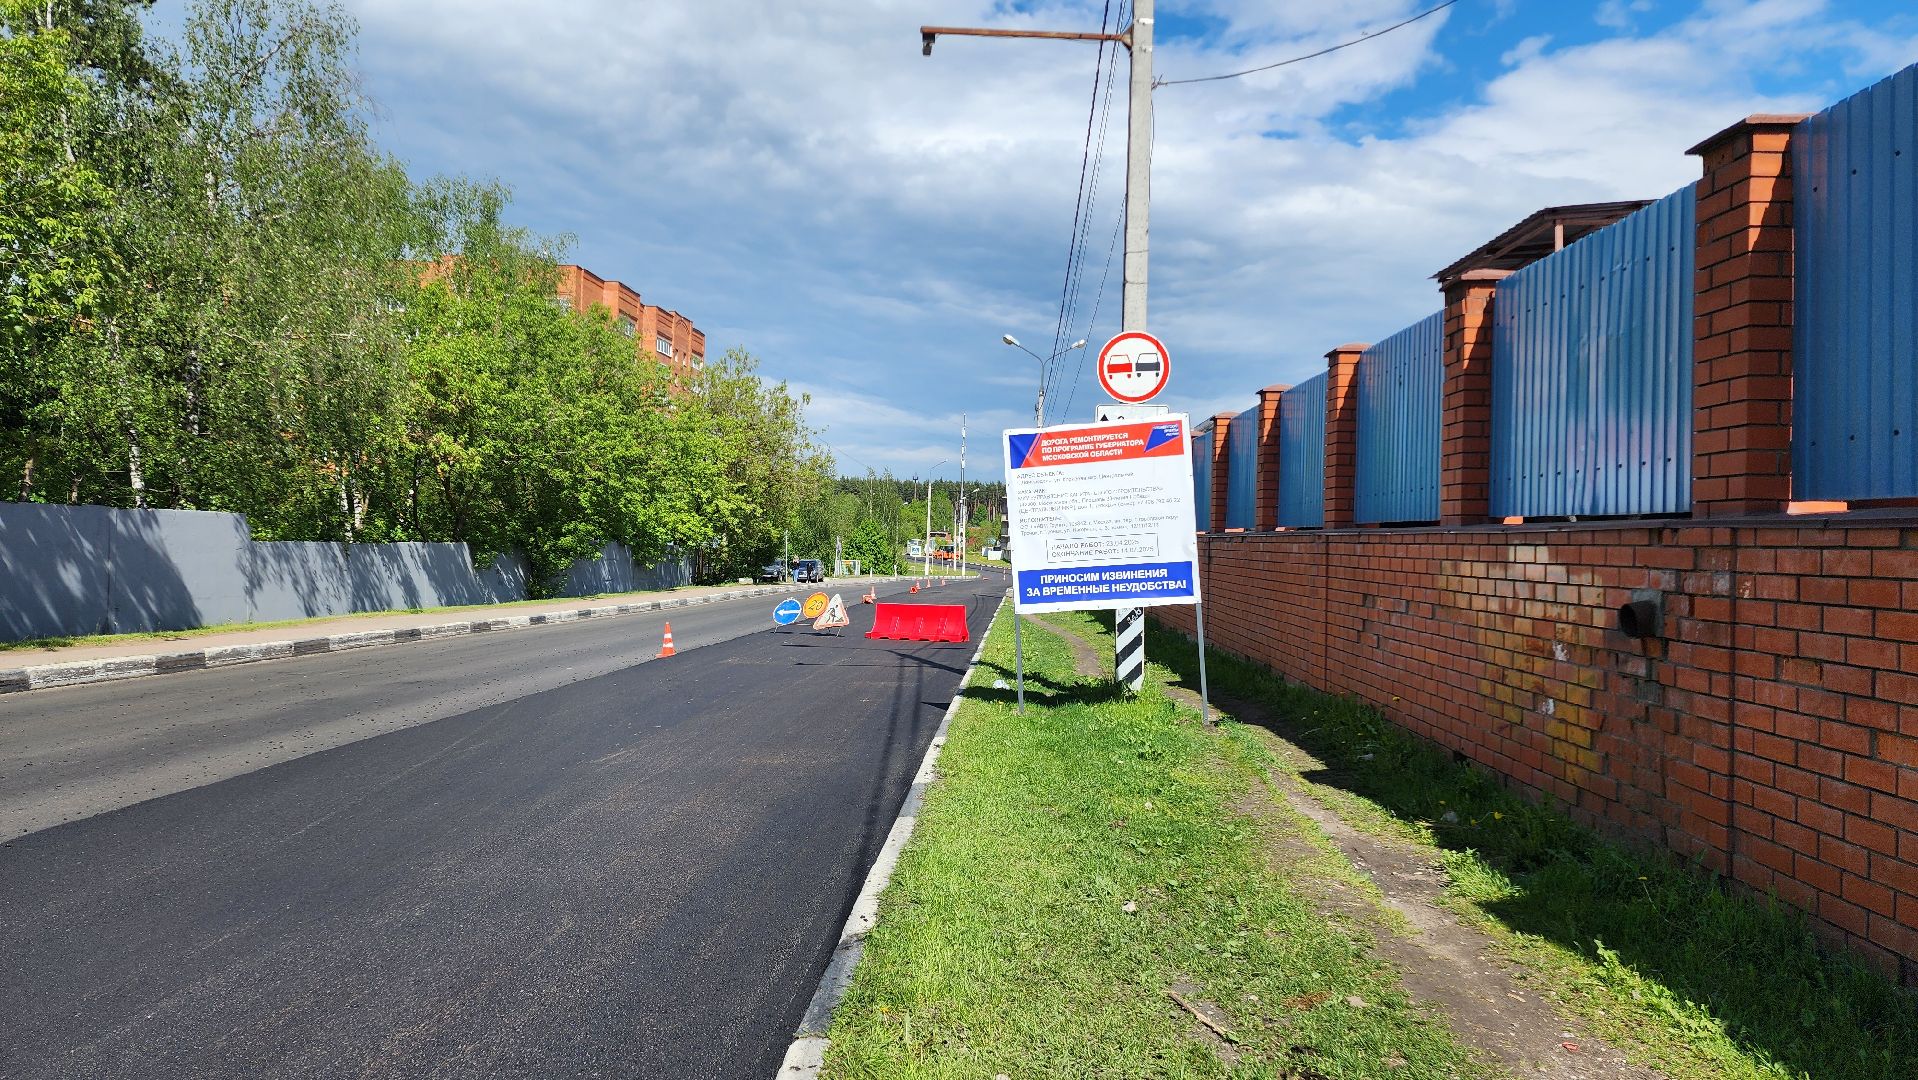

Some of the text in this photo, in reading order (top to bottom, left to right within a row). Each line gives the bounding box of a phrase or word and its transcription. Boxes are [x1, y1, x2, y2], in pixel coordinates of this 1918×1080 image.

[1041, 432, 1129, 447] ДОРОГА РЕМОНТИРУЕТСЯ
[1042, 439, 1145, 454] ПО ПРОГРАММЕ ГУБЕРНАТОРА
[1042, 448, 1123, 462] МОСКОВСКОЙ ОБЛАСТИ
[1040, 568, 1168, 585] ПРИНОСИМ ИЗВИНЕНИЯ
[1026, 580, 1187, 597] ЗА ВРЕМЕННЫЕ НЕУДОБСТВА!
[808, 599, 824, 611] 20
